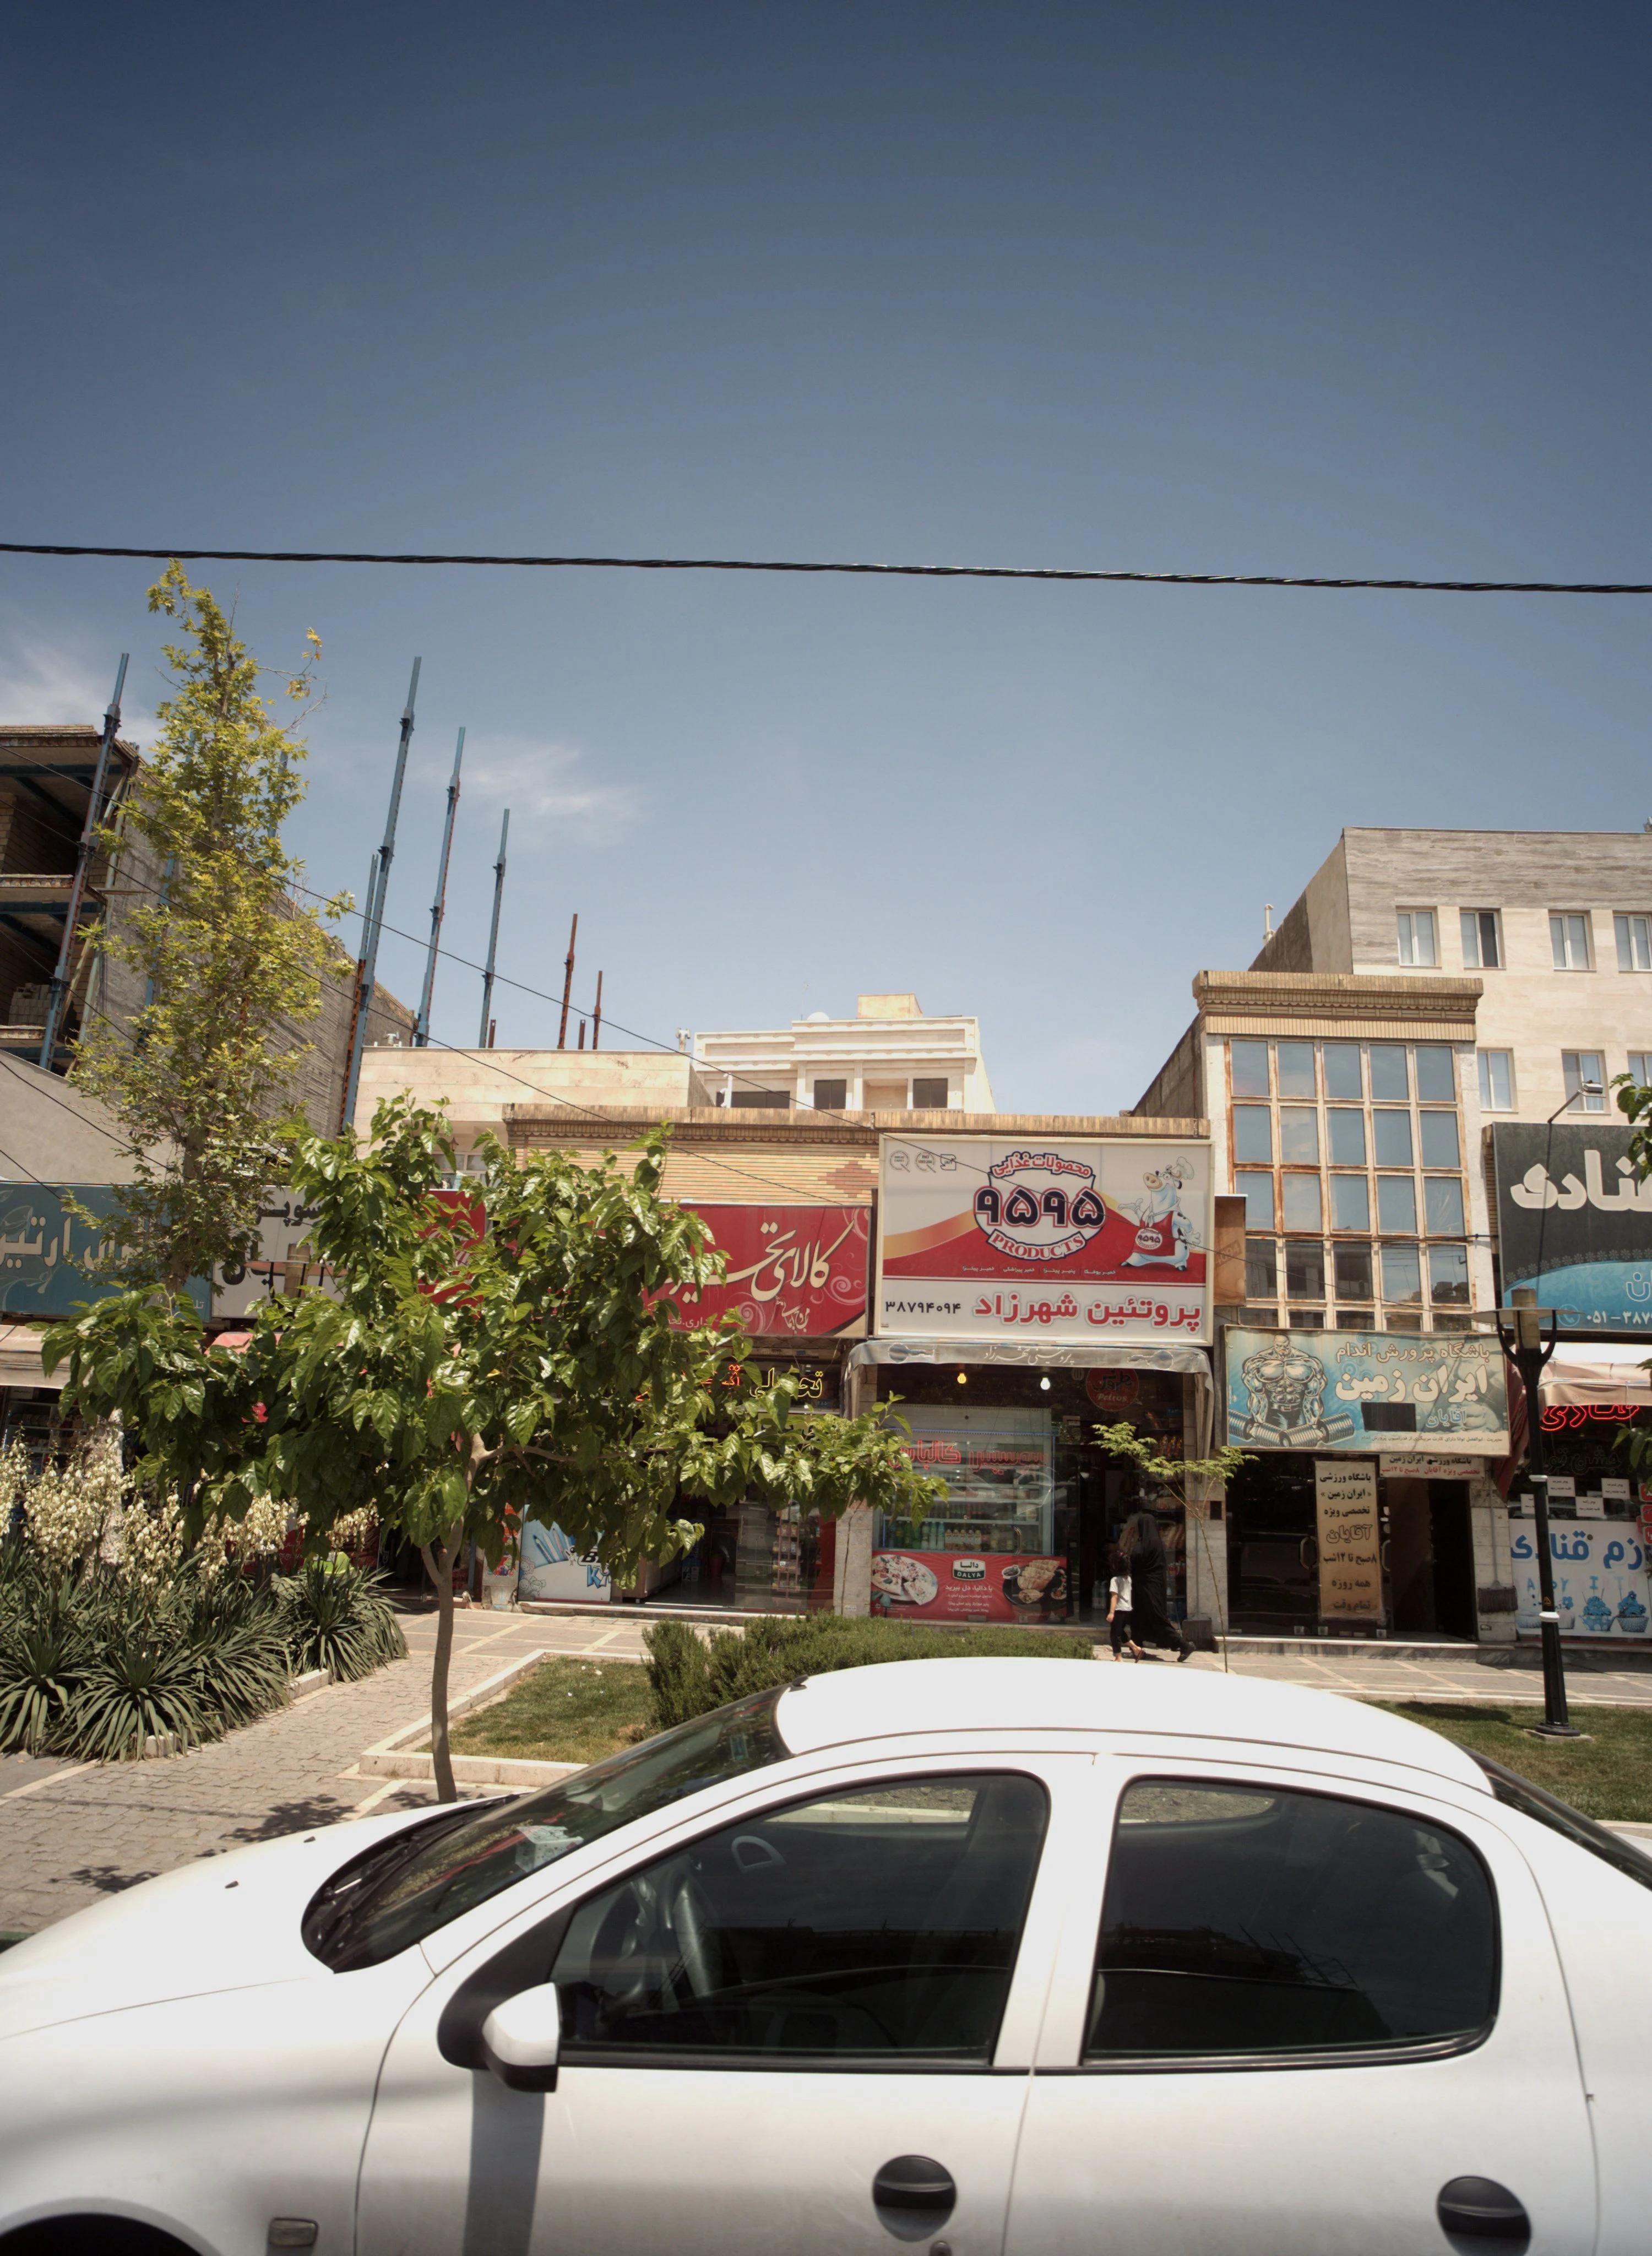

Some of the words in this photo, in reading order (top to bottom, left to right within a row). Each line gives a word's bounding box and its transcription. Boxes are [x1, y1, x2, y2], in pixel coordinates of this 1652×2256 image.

[993, 1154, 1031, 1176] غذایی
[1032, 1156, 1091, 1176] محصولات
[1510, 1149, 1652, 1211] نادی
[974, 1186, 1106, 1228] ۹۵۹۵
[0, 1206, 72, 1268] آرتی
[991, 1233, 1084, 1259] PRODUCTS
[885, 1301, 961, 1315] ۳۸۷۹۴۰۹۴
[973, 1292, 1078, 1324] شهرزاد
[1087, 1296, 1202, 1332] پروتئین
[1586, 1310, 1607, 1324] ۰۵۱
[1622, 1311, 1652, 1325] ۳۸۷
[1336, 1342, 1372, 1364] اندام
[1376, 1344, 1436, 1363] پرورش
[1439, 1342, 1490, 1363] باشگاه
[1335, 1368, 1406, 1403] زمین
[1412, 1363, 1488, 1403] ایران
[1425, 1407, 1468, 1428] آقایان
[1389, 1455, 1405, 1464] زمین
[1406, 1454, 1425, 1465] ایران
[1426, 1456, 1450, 1466] ورزشی
[1451, 1457, 1472, 1466] باشگاه
[1319, 1472, 1347, 1483] ورزشی
[1347, 1472, 1372, 1484] باشگاه
[1423, 1466, 1442, 1475] آقایان
[1327, 1489, 1345, 1500] زمین
[1346, 1488, 1366, 1500] ایران
[1323, 1508, 1340, 1517] ویژه
[1342, 1507, 1371, 1517] تخصصی
[1325, 1524, 1373, 1544] آقایان
[1510, 1530, 1590, 1560] قنای
[1347, 1553, 1354, 1562] تا
[1331, 1579, 1352, 1590] روزه
[1354, 1579, 1371, 1588] همه
[1352, 1600, 1371, 1611] تمام
